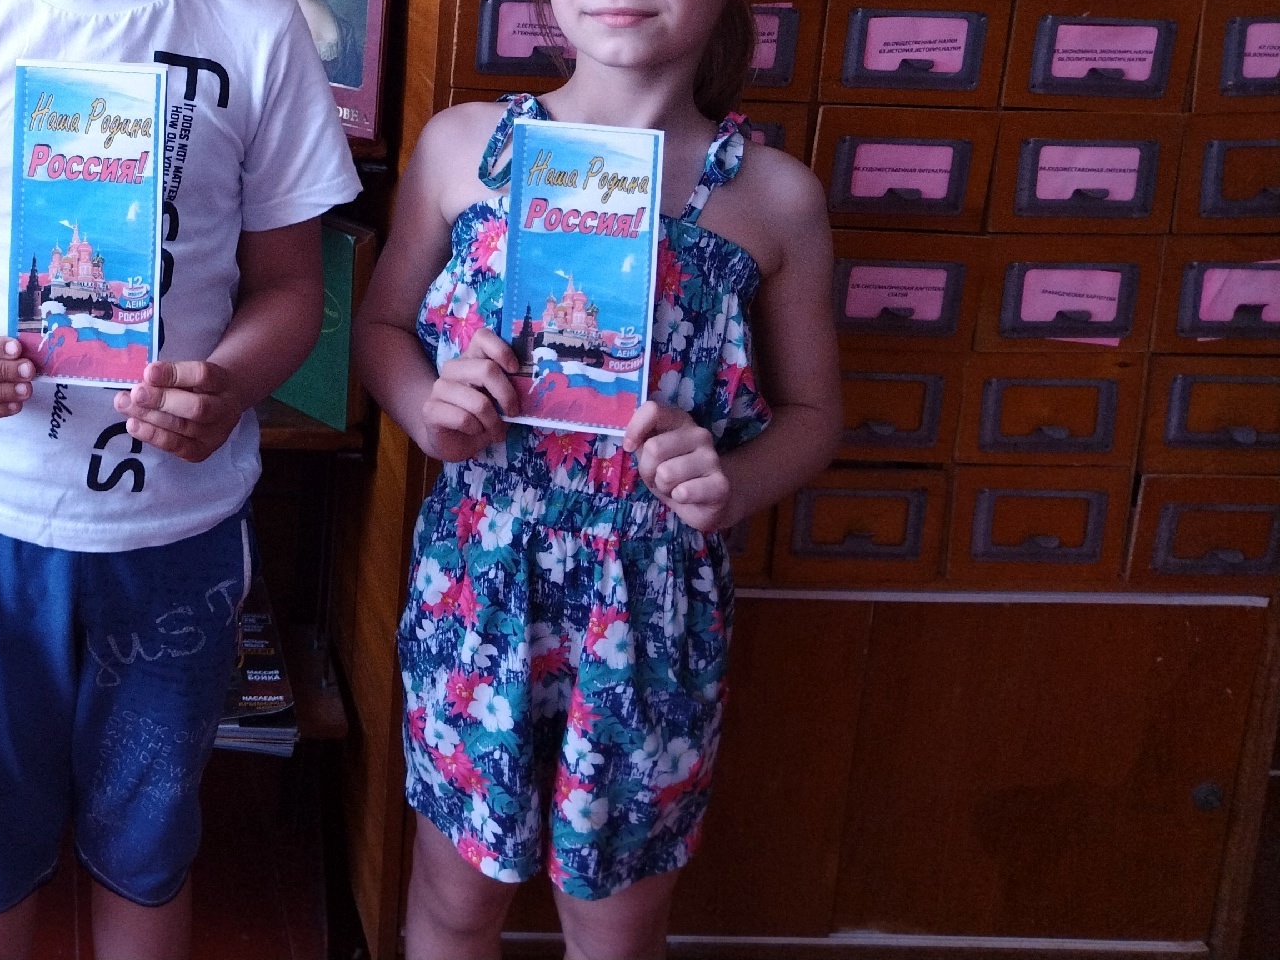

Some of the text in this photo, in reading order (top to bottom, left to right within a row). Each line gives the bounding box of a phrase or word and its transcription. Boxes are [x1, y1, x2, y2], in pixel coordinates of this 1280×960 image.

[29, 91, 153, 149] Наша Родина
[169, 105, 182, 130] HOW
[179, 114, 193, 141] DOES
[166, 132, 177, 152] OLD
[175, 143, 188, 164] NOT
[166, 165, 183, 202] MATTER
[527, 149, 650, 204] Наша Родина
[127, 276, 144, 289] 12
[125, 299, 147, 309] ДЕНЬ
[118, 309, 153, 322] РОССИИ
[620, 326, 635, 338] 12
[616, 348, 637, 358] ДЕНЬ
[609, 357, 644, 371] РОССИИ
